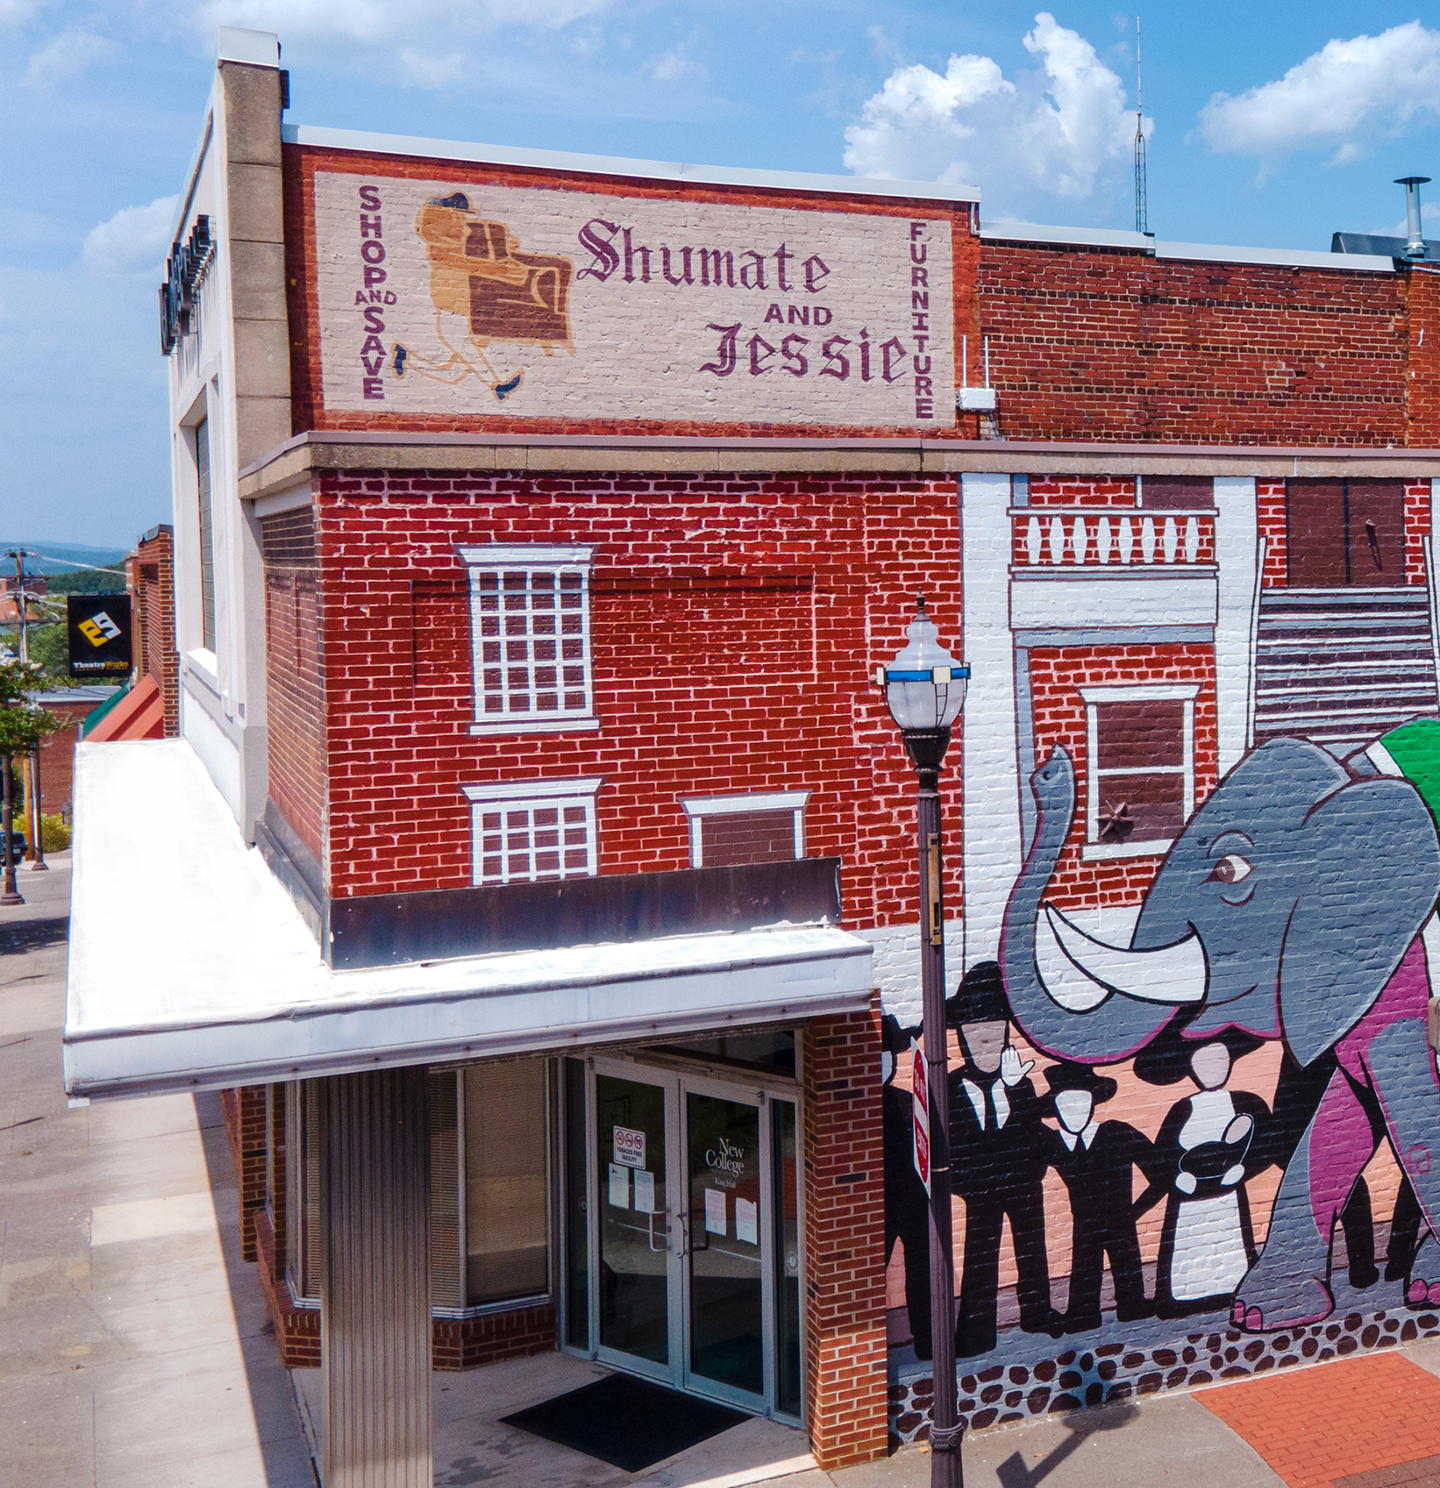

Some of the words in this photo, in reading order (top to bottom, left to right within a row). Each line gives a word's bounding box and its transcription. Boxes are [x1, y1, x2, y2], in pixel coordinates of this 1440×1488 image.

[359, 185, 387, 289] SHOP
[576, 217, 831, 294] Shumate
[354, 290, 397, 306] AND
[764, 304, 833, 326] AND
[909, 222, 934, 419] FURNITURE
[360, 306, 387, 400] SAVE
[699, 322, 908, 384] Jessie
[617, 1146, 633, 1156] TOBACCO
[705, 1149, 745, 1178] College
[719, 1136, 744, 1159] New
